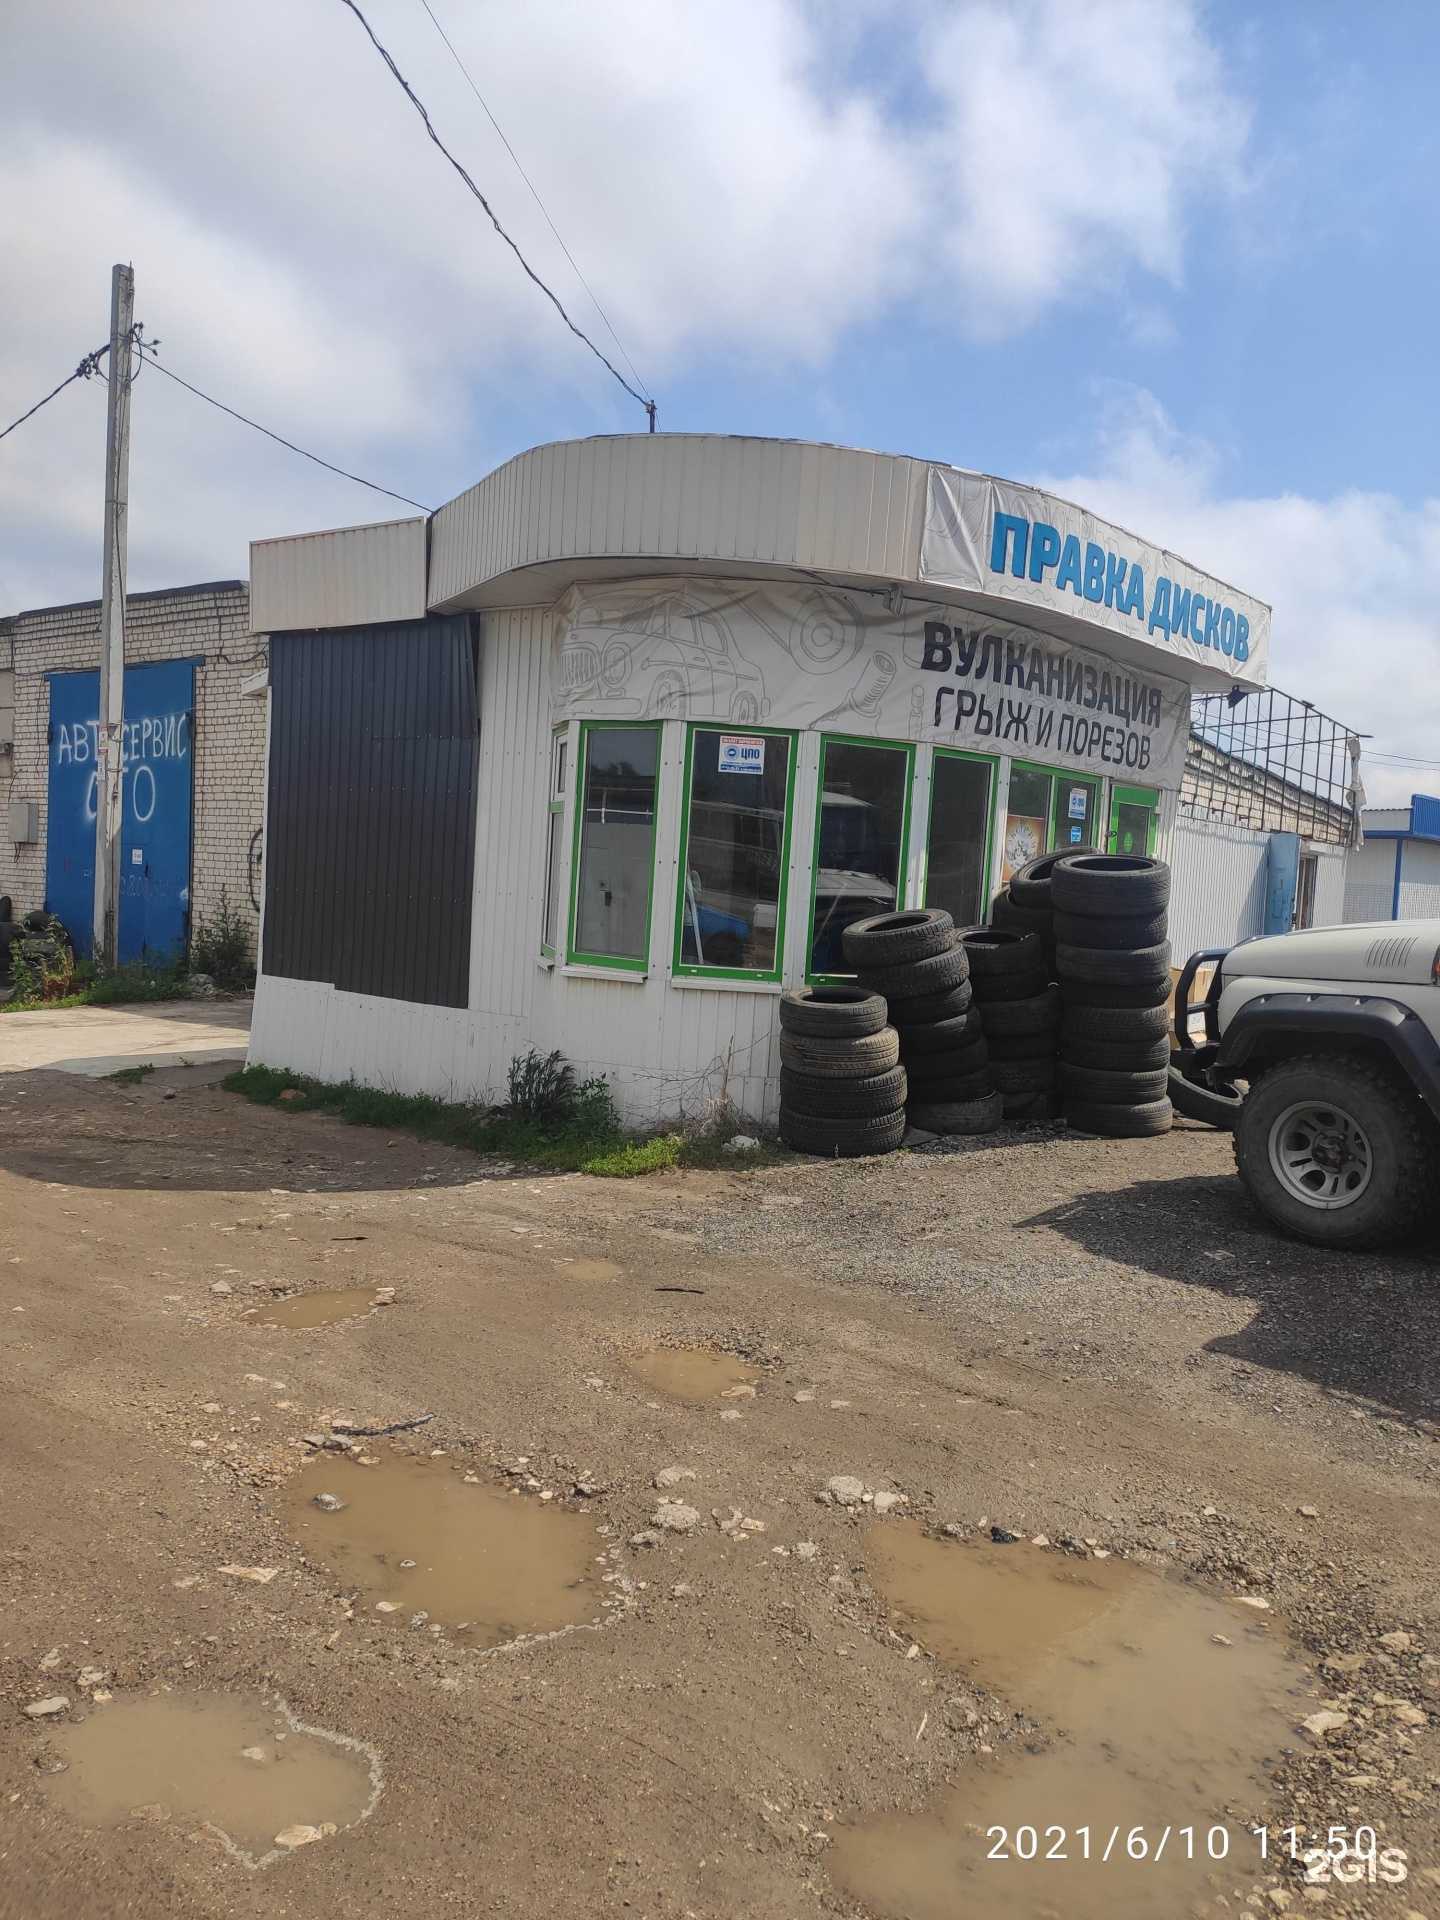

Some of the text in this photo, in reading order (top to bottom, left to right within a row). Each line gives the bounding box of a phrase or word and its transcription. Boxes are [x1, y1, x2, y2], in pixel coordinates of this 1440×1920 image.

[991, 511, 1250, 663] ПРАВКА ДИСКОВ
[920, 620, 1163, 729] ВУЛКАНИЗАЦИЯ
[57, 713, 187, 765] АВТСЕРВИС
[933, 686, 1151, 771] ГРЫЖ И ПОРЕЗОВ
